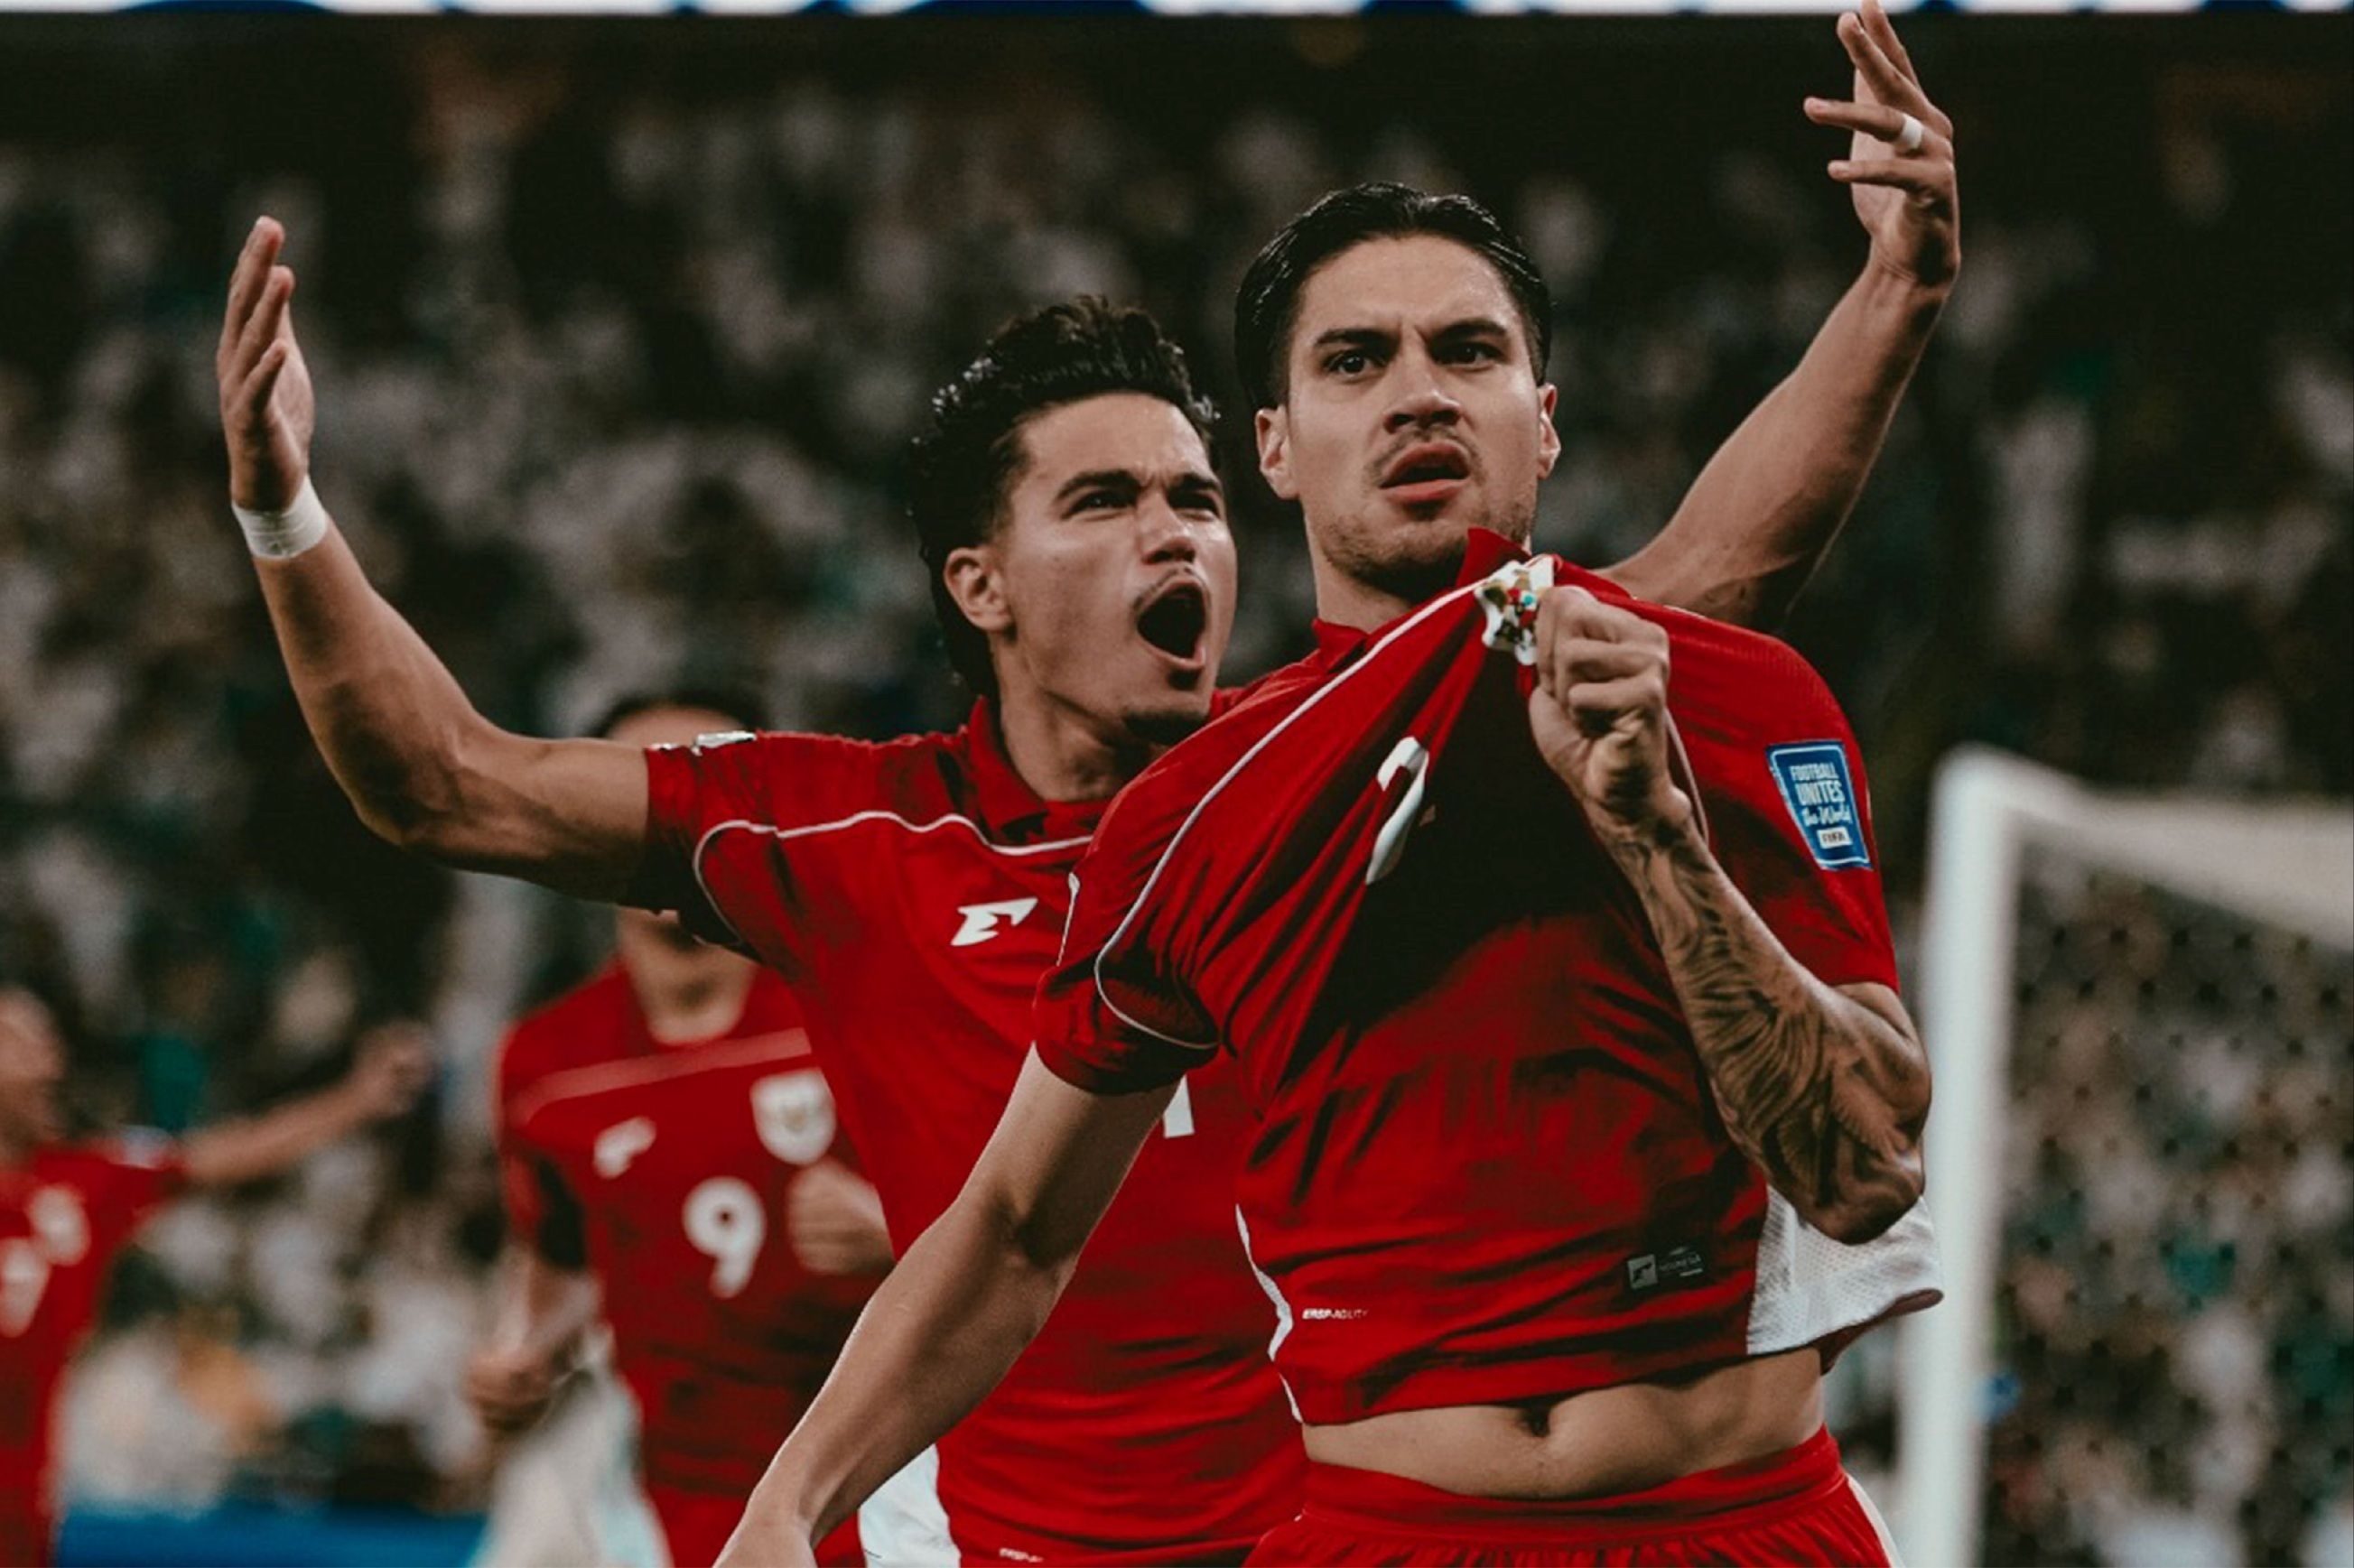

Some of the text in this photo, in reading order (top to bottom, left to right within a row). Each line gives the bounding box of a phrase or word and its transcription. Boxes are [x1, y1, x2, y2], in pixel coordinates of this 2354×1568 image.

[1789, 761, 1839, 782] FOOTBALL
[1794, 780, 1846, 806] UNITES
[684, 1176, 767, 1298] 9
